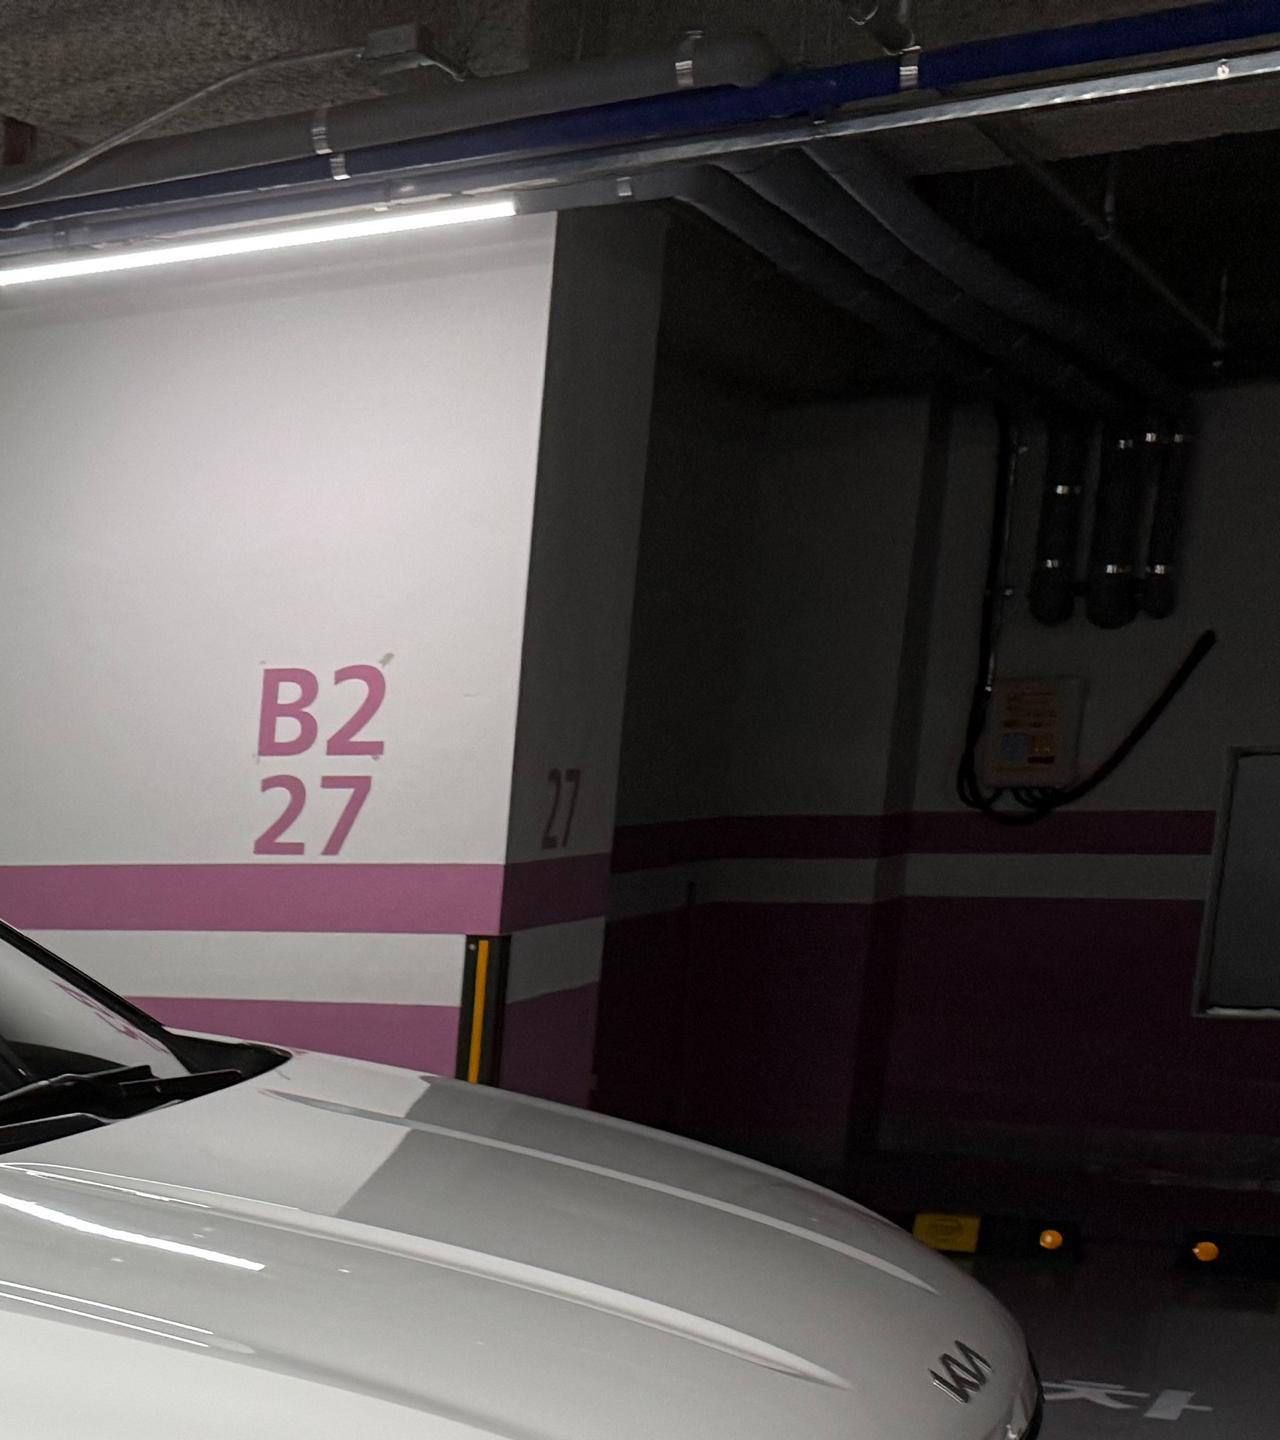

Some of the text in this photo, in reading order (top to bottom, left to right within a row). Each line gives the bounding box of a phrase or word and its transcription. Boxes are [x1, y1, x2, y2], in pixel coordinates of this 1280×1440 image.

[257, 664, 387, 757] B2
[253, 774, 373, 856] 27
[542, 768, 582, 850] 27
